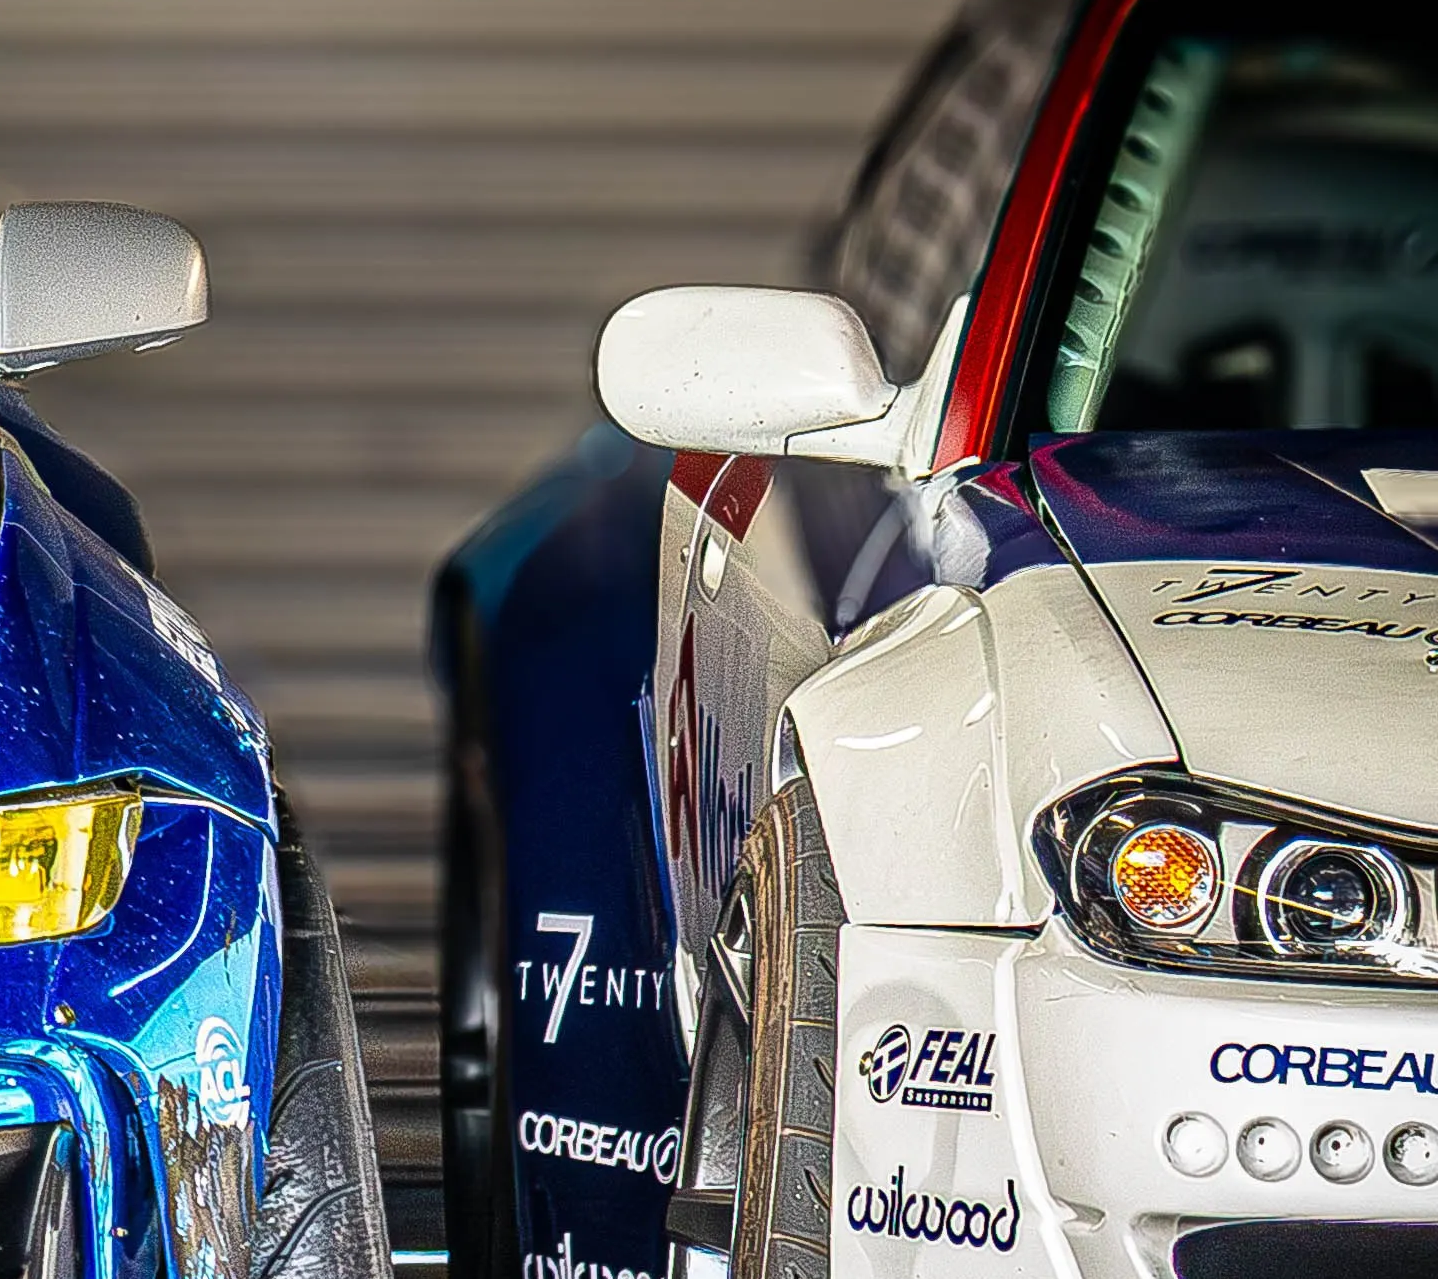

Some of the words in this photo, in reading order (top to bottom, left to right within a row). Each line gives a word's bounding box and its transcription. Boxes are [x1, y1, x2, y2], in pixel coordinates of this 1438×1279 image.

[1152, 611, 1426, 639] CORBEAU
[198, 1061, 250, 1102] ACL
[909, 1029, 997, 1087] FEAL
[906, 1088, 990, 1108] Suspension
[519, 1111, 655, 1172] CORBEAU
[848, 1165, 1021, 1252] wilwood
